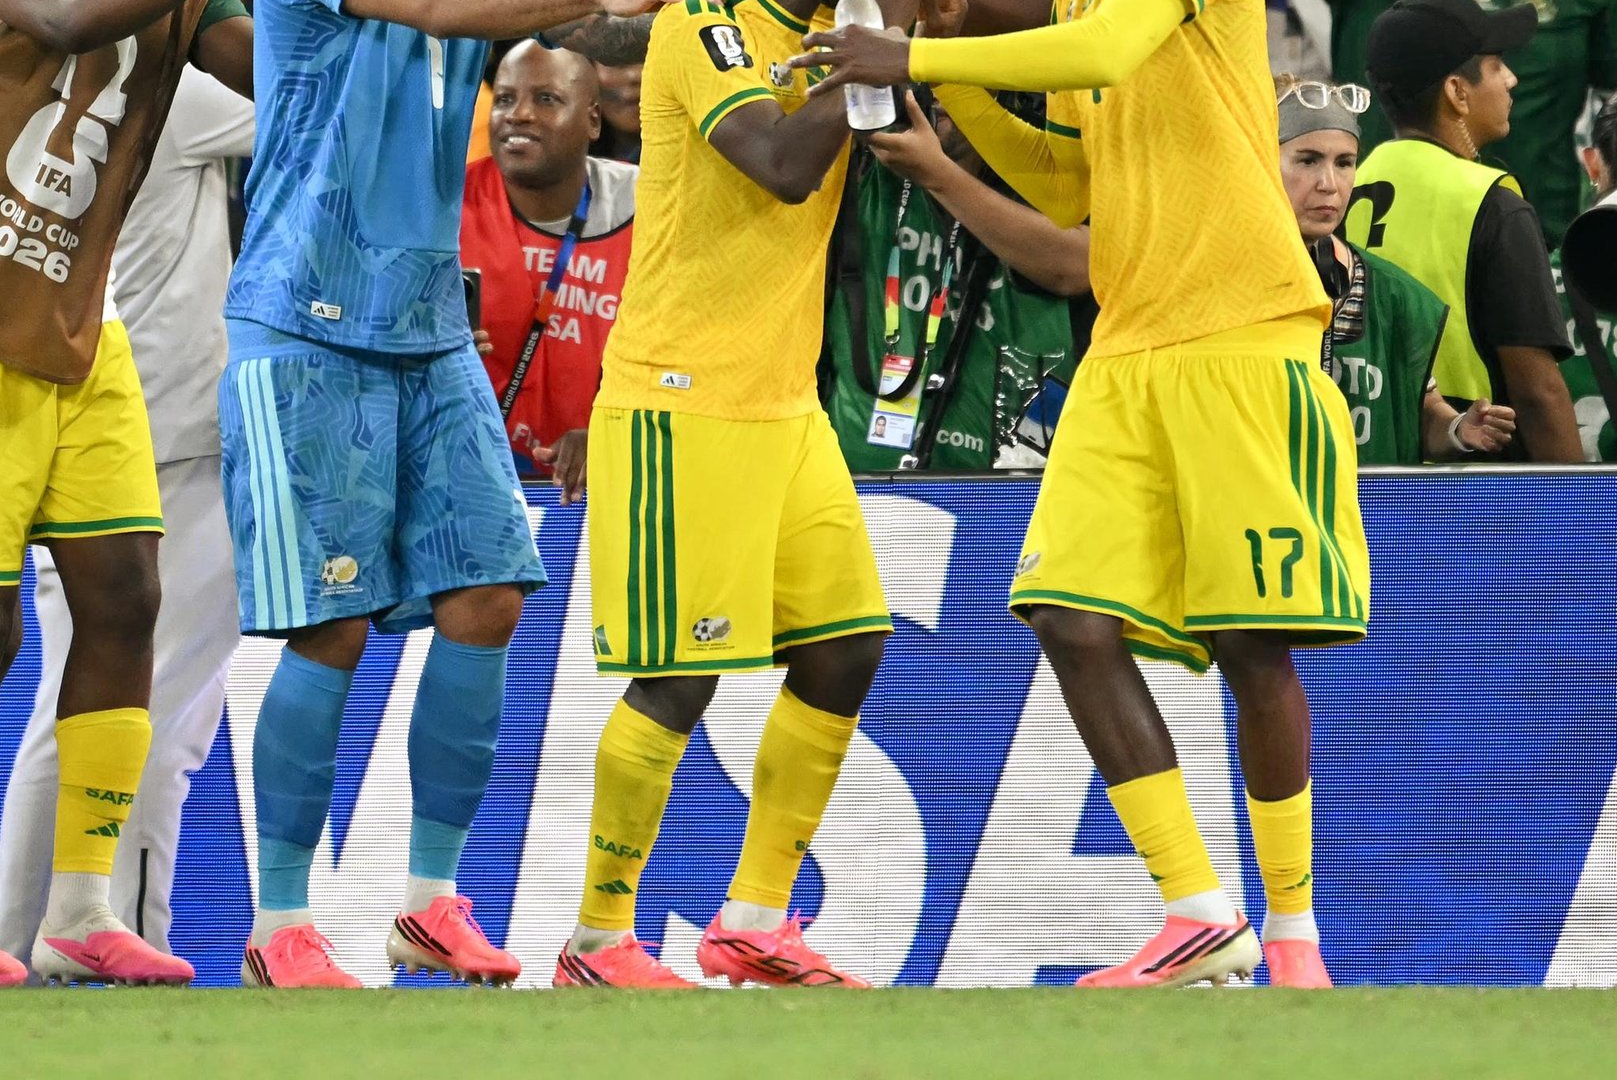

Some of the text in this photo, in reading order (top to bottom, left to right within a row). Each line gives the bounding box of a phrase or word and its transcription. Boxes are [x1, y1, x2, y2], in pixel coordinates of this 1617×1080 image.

[45, 223, 80, 251] CUP
[522, 246, 607, 285] TEAM
[543, 314, 582, 345] SA
[502, 331, 540, 411] WORLD CUP 2026
[1245, 527, 1303, 598] 17
[594, 834, 643, 861] SAFA
